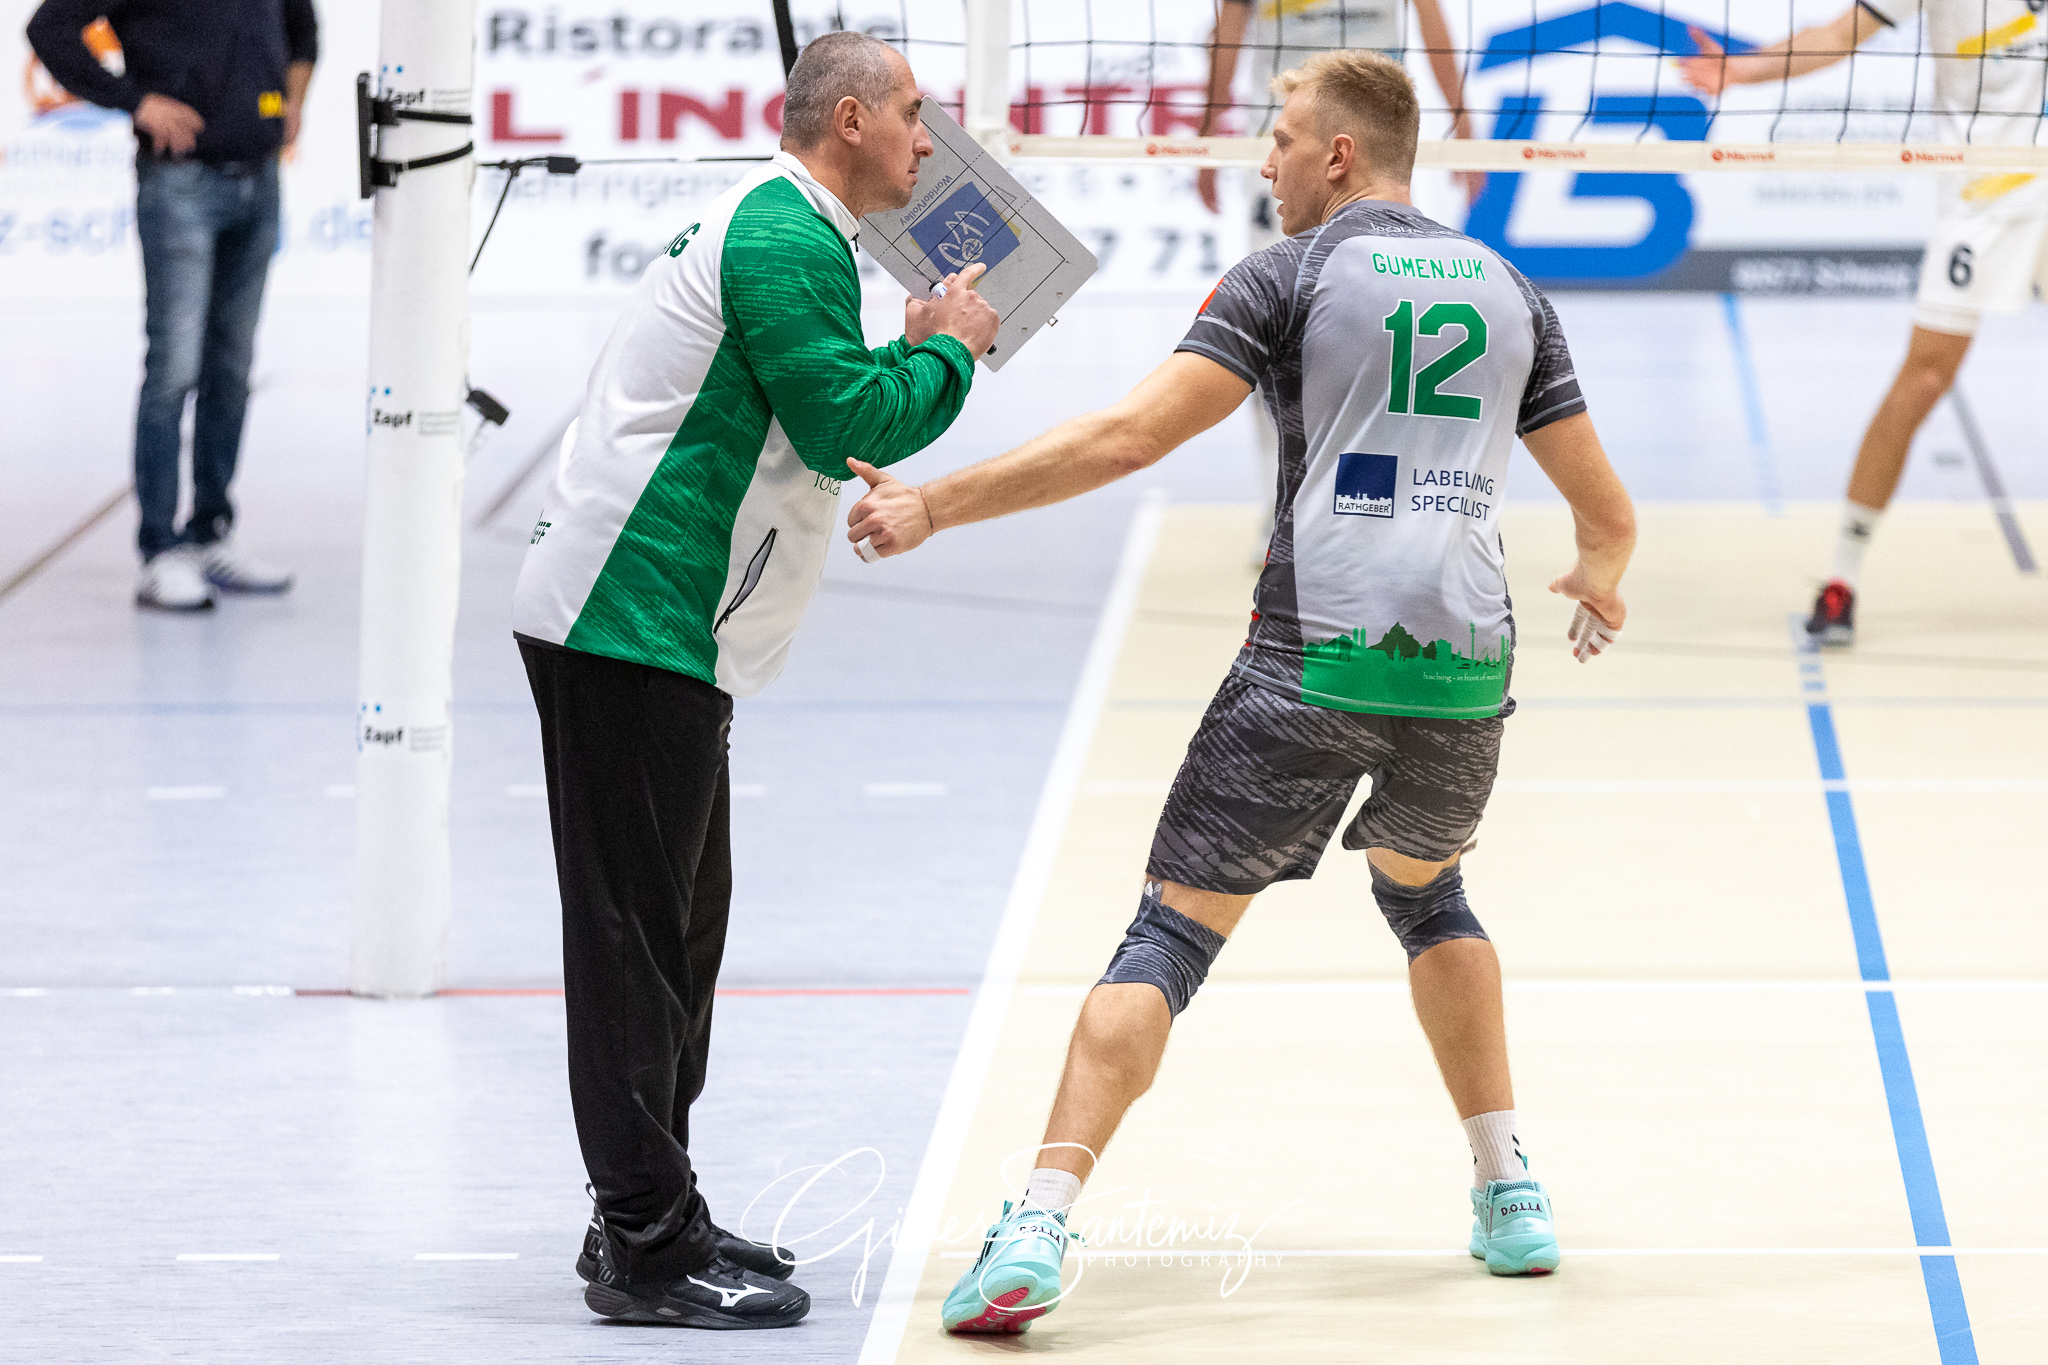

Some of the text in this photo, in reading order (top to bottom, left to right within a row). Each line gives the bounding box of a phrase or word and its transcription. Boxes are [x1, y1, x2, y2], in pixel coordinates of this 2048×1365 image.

[899, 175, 953, 227] WorldofVolley
[1371, 252, 1487, 282] GUMENJUK
[1948, 243, 1973, 289] 6
[1383, 298, 1489, 422] 12
[374, 408, 412, 429] Zapf
[1413, 468, 1494, 496] LABELING
[1411, 495, 1490, 521] SPECILIST
[365, 725, 402, 746] Zapf
